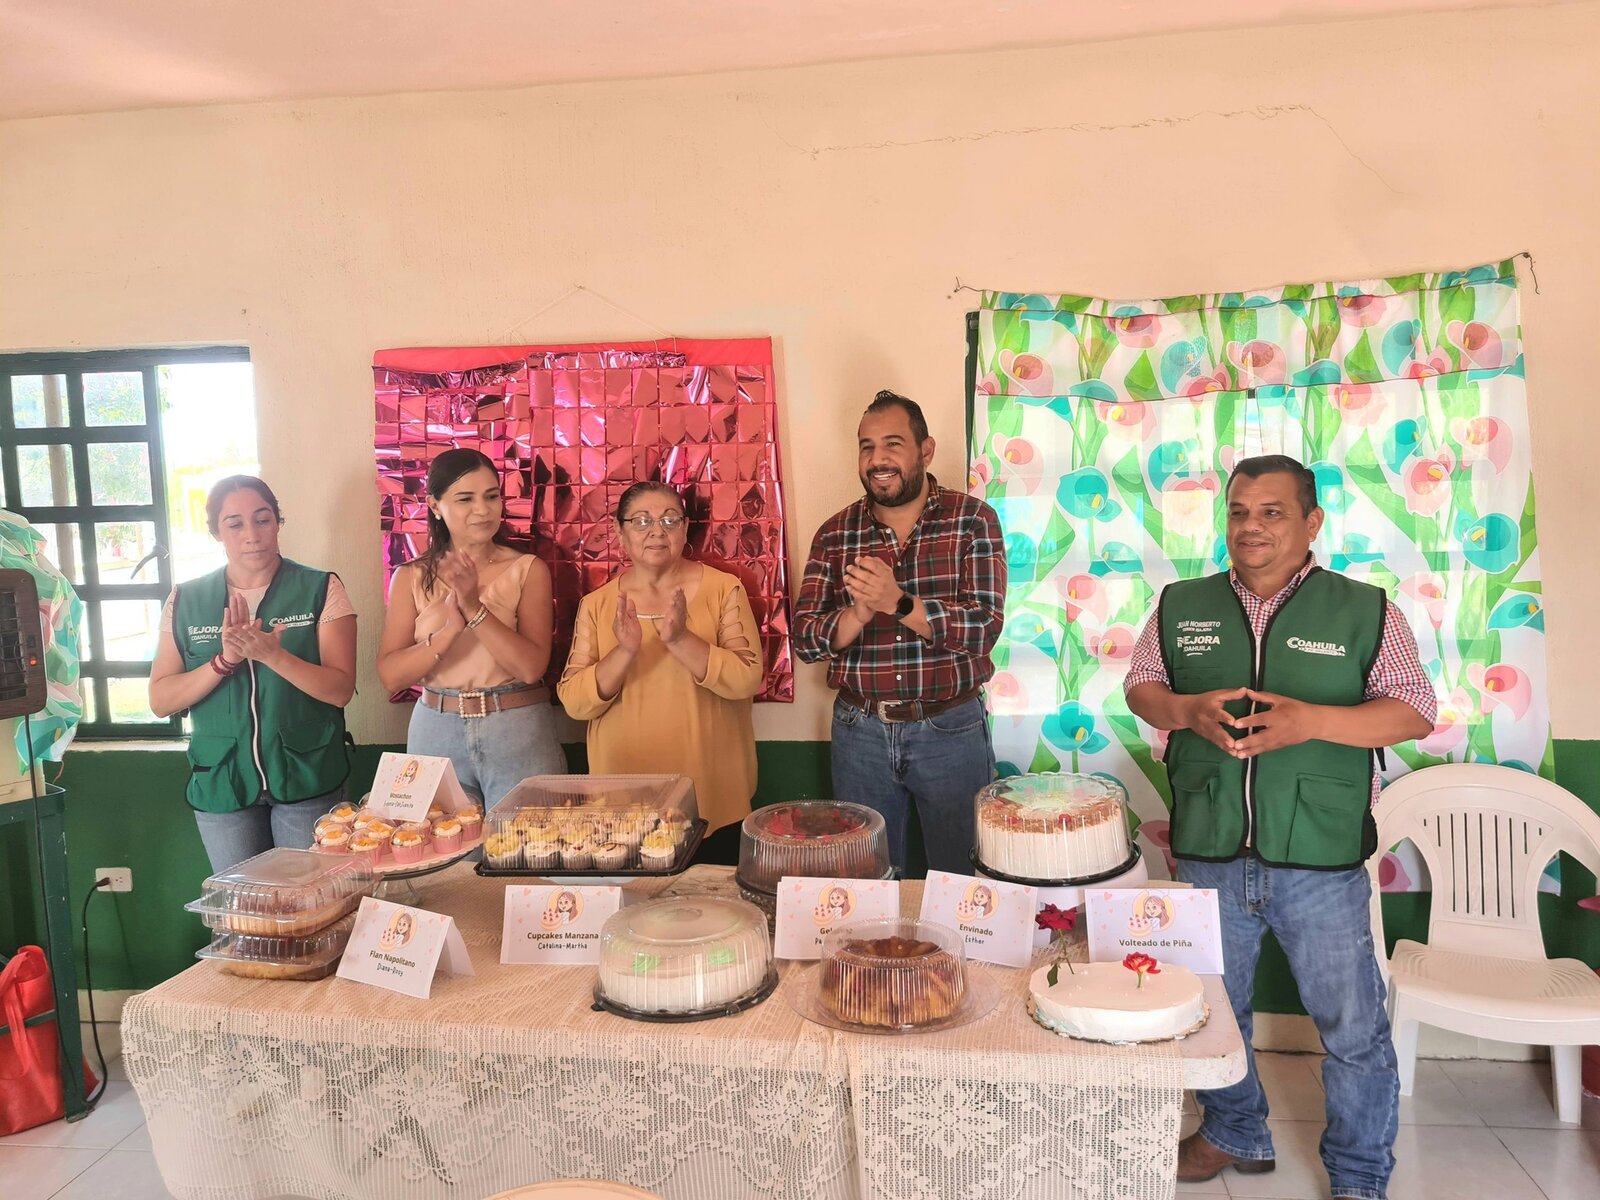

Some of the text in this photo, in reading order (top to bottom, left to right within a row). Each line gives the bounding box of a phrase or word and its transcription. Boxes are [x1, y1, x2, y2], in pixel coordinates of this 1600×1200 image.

[268, 612, 314, 628] COAHUILA
[1286, 636, 1346, 653] COAHUILA
[959, 923, 994, 936] Envinado
[527, 932, 563, 941] Cupcakes
[965, 935, 985, 945] Esther
[537, 942, 588, 950] Catalina-Martha
[1119, 939, 1193, 948] Volteado de Piña
[369, 950, 416, 968] Flan Napolitano
